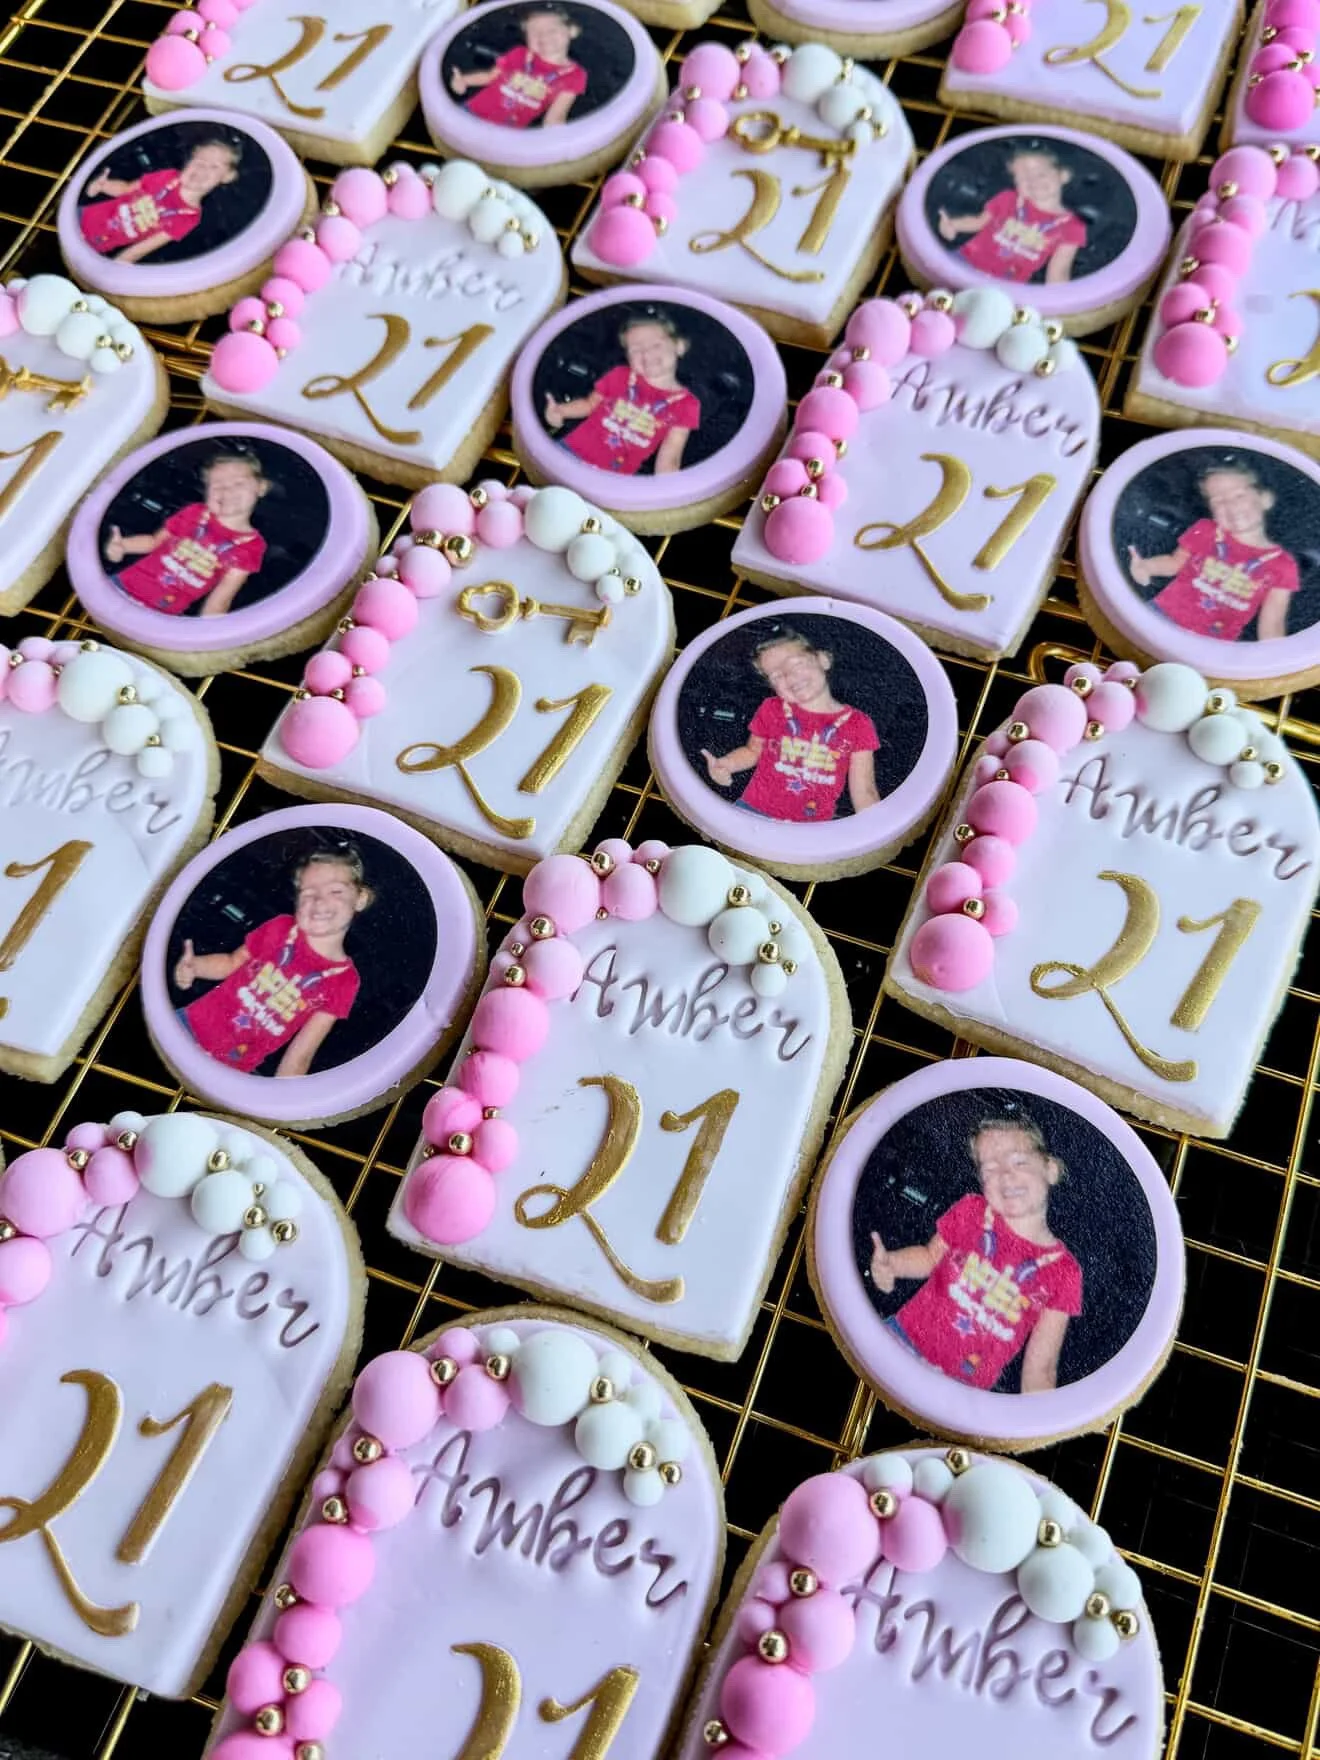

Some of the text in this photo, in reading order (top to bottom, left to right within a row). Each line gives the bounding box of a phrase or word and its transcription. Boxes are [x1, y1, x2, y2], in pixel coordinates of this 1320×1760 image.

[223, 16, 393, 119] 21
[1042, 0, 1201, 99] 21
[688, 168, 852, 284] 21
[301, 312, 496, 445] 21
[890, 360, 1089, 458] Amber
[854, 452, 1058, 612] 21
[0, 728, 182, 835] mber
[396, 664, 614, 841] 21
[1059, 754, 1312, 881] Amber
[568, 944, 812, 1062] Amber
[1030, 870, 1262, 1083] 21
[514, 1073, 741, 1304] 21
[71, 1200, 321, 1349] Amber
[0, 1369, 233, 1638] 21
[411, 1429, 688, 1608] Amber
[840, 1554, 1139, 1746] Amber
